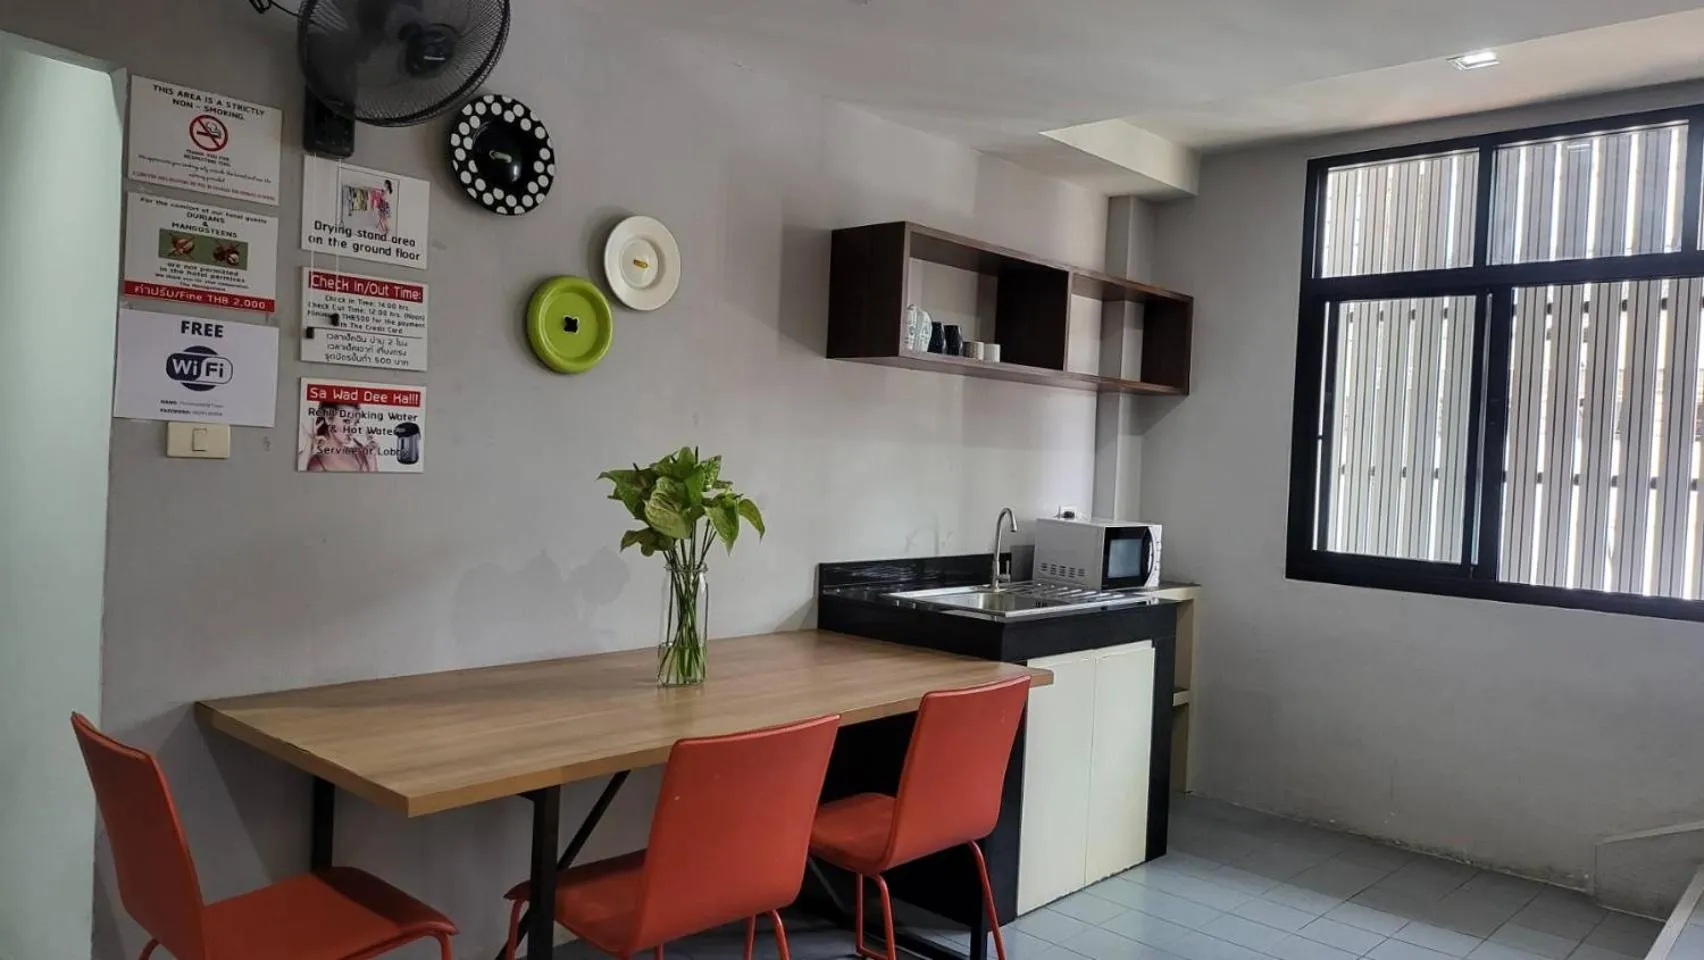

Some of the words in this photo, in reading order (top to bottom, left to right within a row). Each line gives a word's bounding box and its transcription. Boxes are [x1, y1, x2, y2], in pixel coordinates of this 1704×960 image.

[152, 84, 174, 96] THIS
[177, 90, 202, 102] AREA
[204, 95, 213, 104] IS
[226, 101, 265, 116] STRICTLY
[172, 98, 193, 109] NON
[156, 199, 168, 208] the
[186, 211, 225, 224] DURIANS
[171, 222, 238, 239] MANGOSTEENS
[314, 220, 352, 238] Drying
[357, 228, 387, 242] stand
[391, 235, 416, 248] area
[308, 235, 323, 245] on
[328, 237, 347, 249] the
[352, 242, 392, 257] ground
[396, 247, 420, 261] floor
[311, 274, 349, 292] Check
[353, 280, 389, 297] In/Out
[207, 293, 229, 306] THB
[325, 294, 346, 304] Check
[180, 320, 224, 338] FREE
[374, 356, 392, 365] 500
[309, 387, 327, 399] Sa
[333, 388, 359, 401] Wad
[363, 390, 388, 403] Dee
[339, 409, 384, 422] Drinking
[388, 411, 418, 422] Water
[342, 425, 362, 435] Hot
